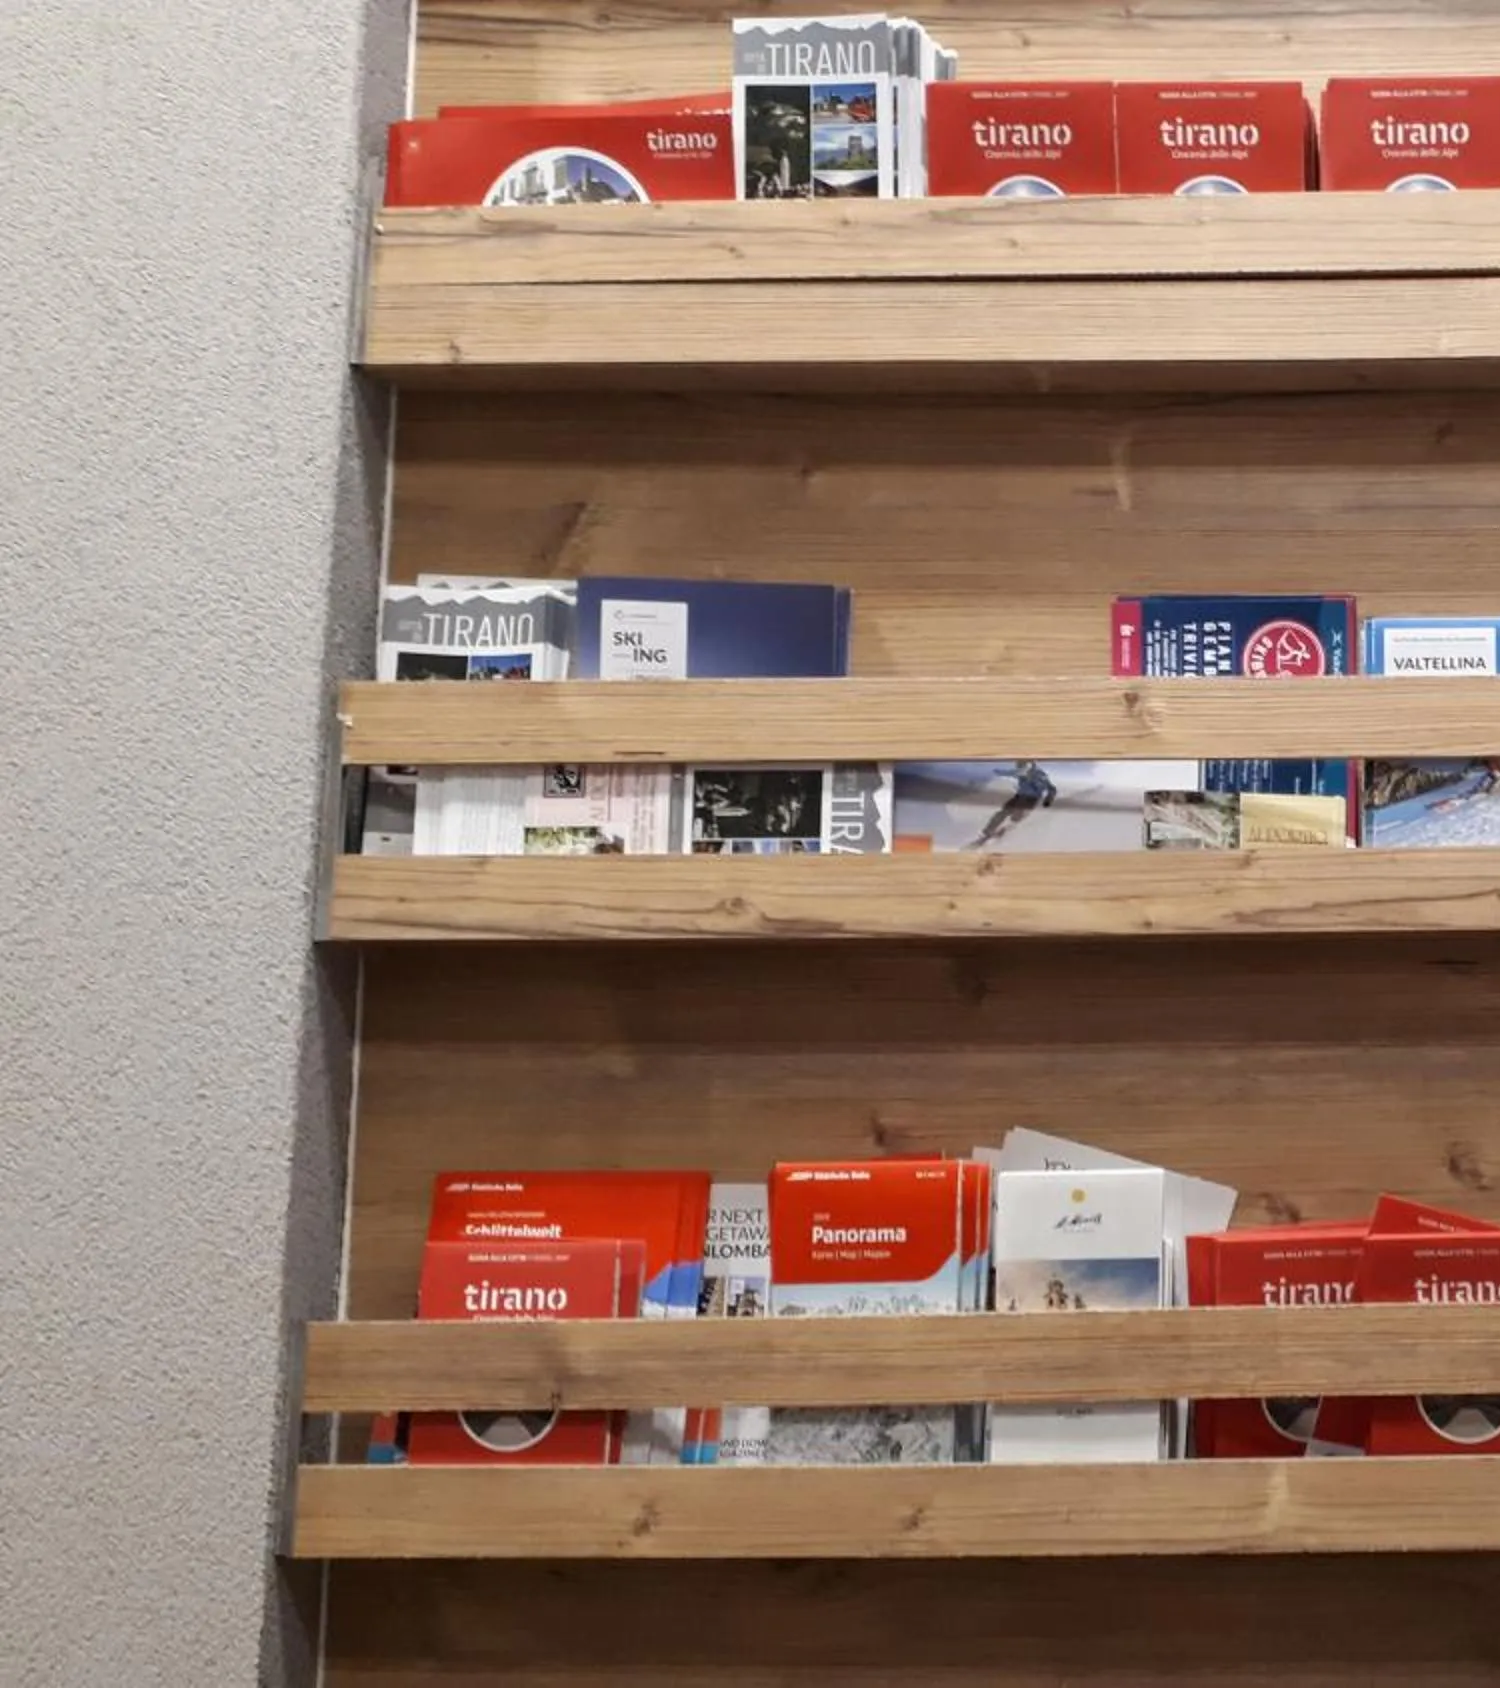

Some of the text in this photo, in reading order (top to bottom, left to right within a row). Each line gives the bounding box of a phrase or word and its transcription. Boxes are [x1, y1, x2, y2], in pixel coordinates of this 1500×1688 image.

[764, 41, 876, 76] TIRANO
[646, 128, 718, 152] tirano
[971, 116, 1072, 147] tirano
[1160, 116, 1260, 147] tirano
[1370, 115, 1471, 145] tirano
[422, 612, 534, 647] TIRANO
[613, 631, 643, 646] SKI
[633, 648, 668, 663] ING
[1393, 657, 1487, 670] VALTELLINA
[721, 1208, 763, 1224] NEXT
[811, 1226, 907, 1243] Panorama
[464, 1280, 567, 1311] tirano
